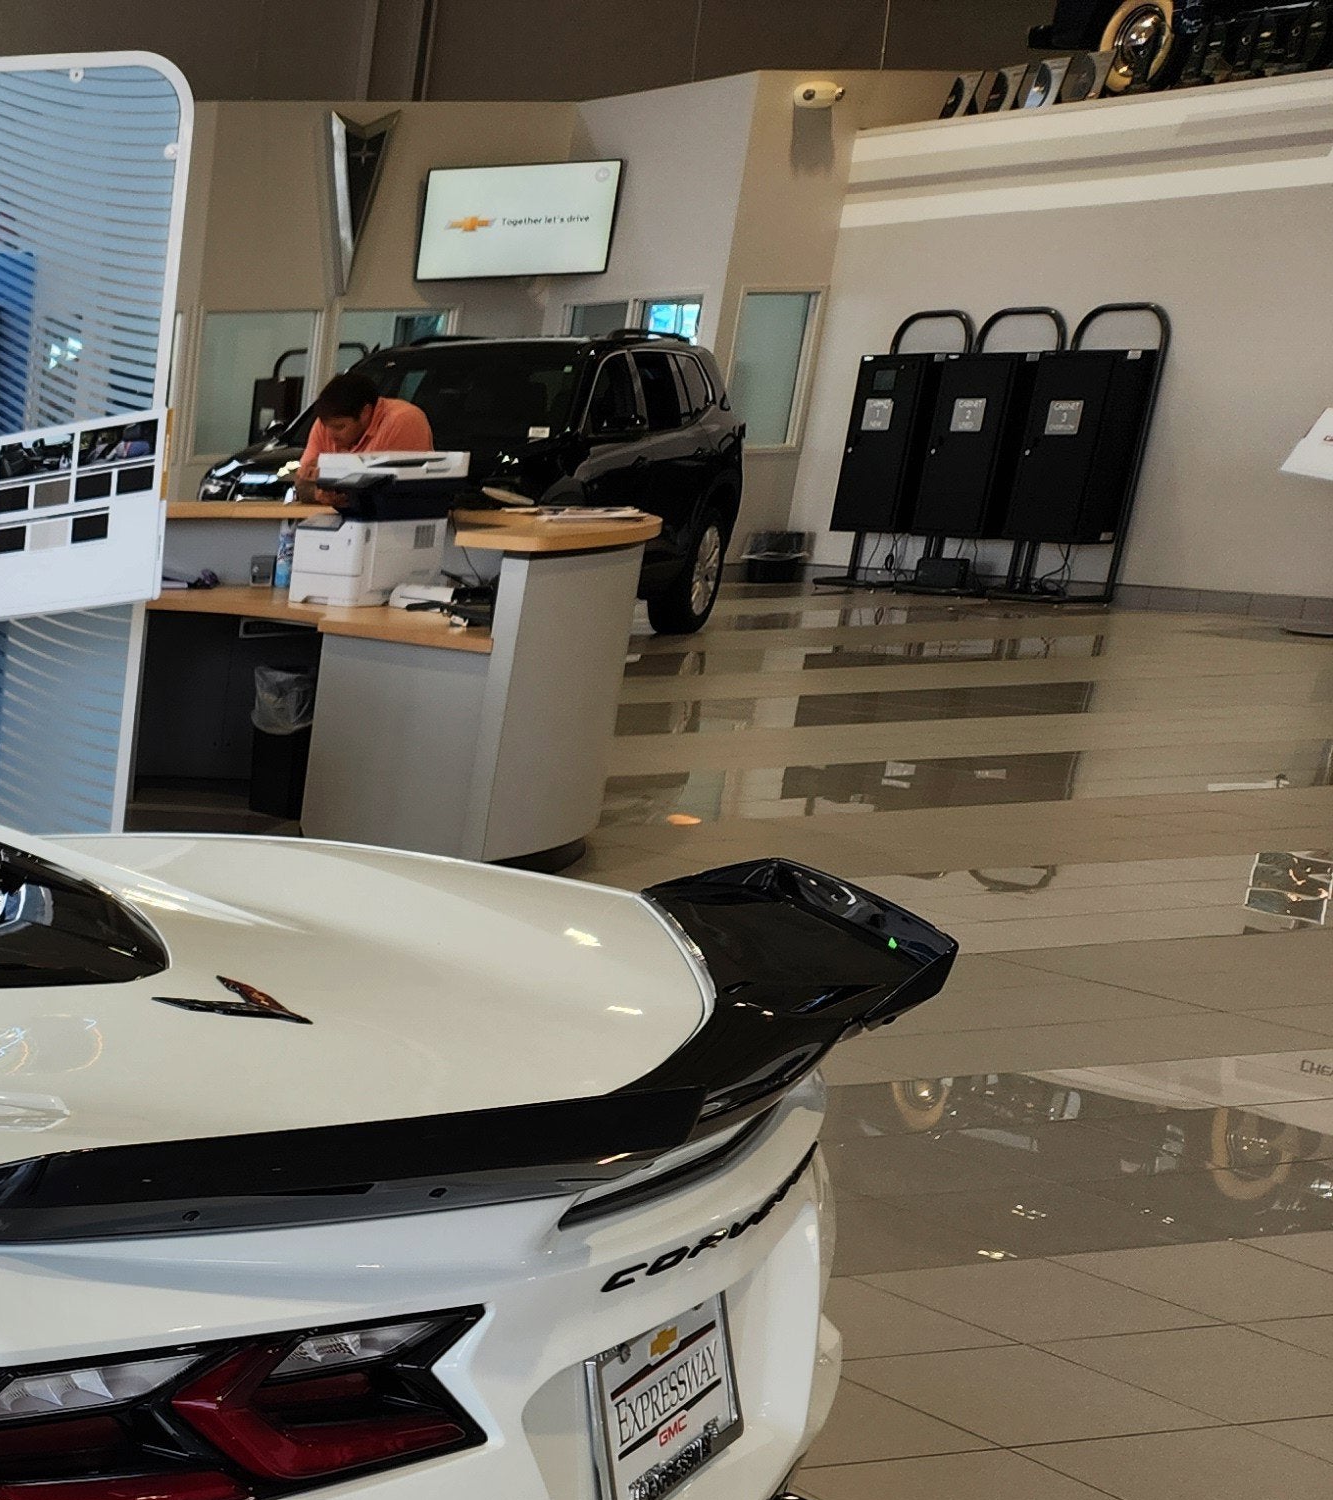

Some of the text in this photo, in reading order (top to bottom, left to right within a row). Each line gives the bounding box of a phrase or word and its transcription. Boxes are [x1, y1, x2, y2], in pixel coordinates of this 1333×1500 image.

[501, 217, 542, 226] Together
[566, 215, 590, 223] drive
[965, 410, 972, 420] 2
[614, 1340, 719, 1448] EXPRESSWAY
[658, 1414, 688, 1447] GMC
